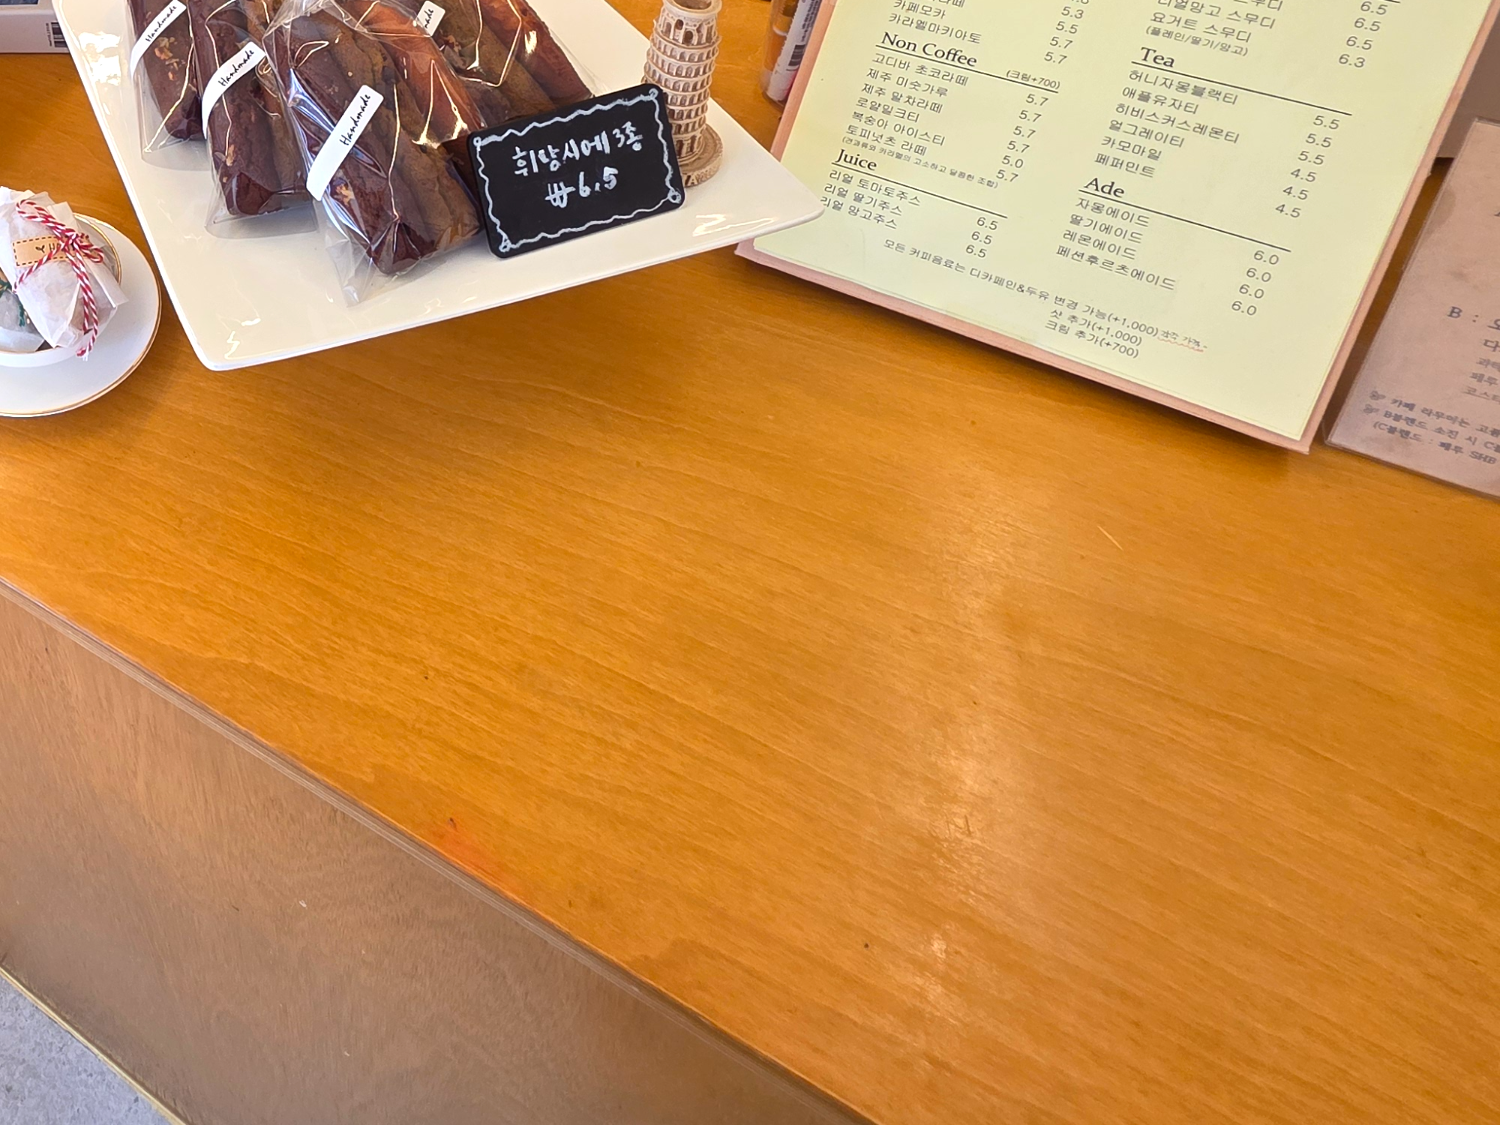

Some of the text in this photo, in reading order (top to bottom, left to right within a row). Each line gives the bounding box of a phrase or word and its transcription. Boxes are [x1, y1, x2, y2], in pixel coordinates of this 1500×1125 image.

[145, 4, 178, 43] Handmade
[894, 0, 1073, 49] 카페모카 5.7
[1056, 21, 1078, 34] 5.5
[1062, 6, 1084, 19] 5.3
[1226, 10, 1276, 29] 스무디
[1346, 35, 1373, 51] 6.5
[1354, 17, 1381, 32] 6.5
[1360, 1, 1388, 15] 6.5
[881, 32, 1060, 90] Non Coffee (크림+700)
[1044, 52, 1067, 65] 5.7
[1140, 47, 1175, 68] Tea
[1150, 12, 1366, 68] 요거트 스무디 6.3
[217, 49, 255, 87] Handmade
[872, 53, 1049, 107] 고디바 초코라떼 5.7
[339, 93, 371, 146] Handmade
[861, 83, 1036, 139] 제주 말차라떼 5.7
[867, 68, 1042, 123] 제주 미숫가루 5.7
[1122, 86, 1332, 148] 애플유자티 5.5
[1129, 69, 1340, 130] 허니자몽블랙티 5.5
[852, 111, 1024, 169] 복숭아 아이스티 5.0
[856, 97, 1030, 154] 로얄밀크티 5.7
[1108, 119, 1317, 183] 얼그레이티 4.5
[1115, 103, 1325, 165] 히비스커스레몬티 5.5
[835, 149, 877, 171] Juice
[846, 125, 1019, 183] 토피넛츠 라떼 5.7
[1101, 136, 1309, 200] 카모마일 4.5
[829, 170, 998, 231] 리얼 토마토주스 6.5
[1084, 178, 1125, 198] Ade
[1094, 153, 1302, 218] 페퍼민트 4.5
[824, 183, 993, 245] 리얼 딸기주스 6.5
[848, 205, 897, 230] 망고주스
[966, 245, 987, 258] 6.5
[1076, 198, 1279, 265] 자몽에이드 6.0
[884, 239, 1079, 310] 모든 커피음료는 디카페인&두유 변경
[1062, 230, 1264, 299] 레몬에이드 6.0
[1070, 214, 1272, 283] 딸기에이드 6.0
[1050, 308, 1064, 321] 샷
[1231, 301, 1257, 316] 6.0
[1045, 319, 1071, 336] 크림
[1075, 328, 1140, 358] 추가(+700)
[1465, 436, 1477, 445] 시
[1469, 451, 1497, 464] SHB
